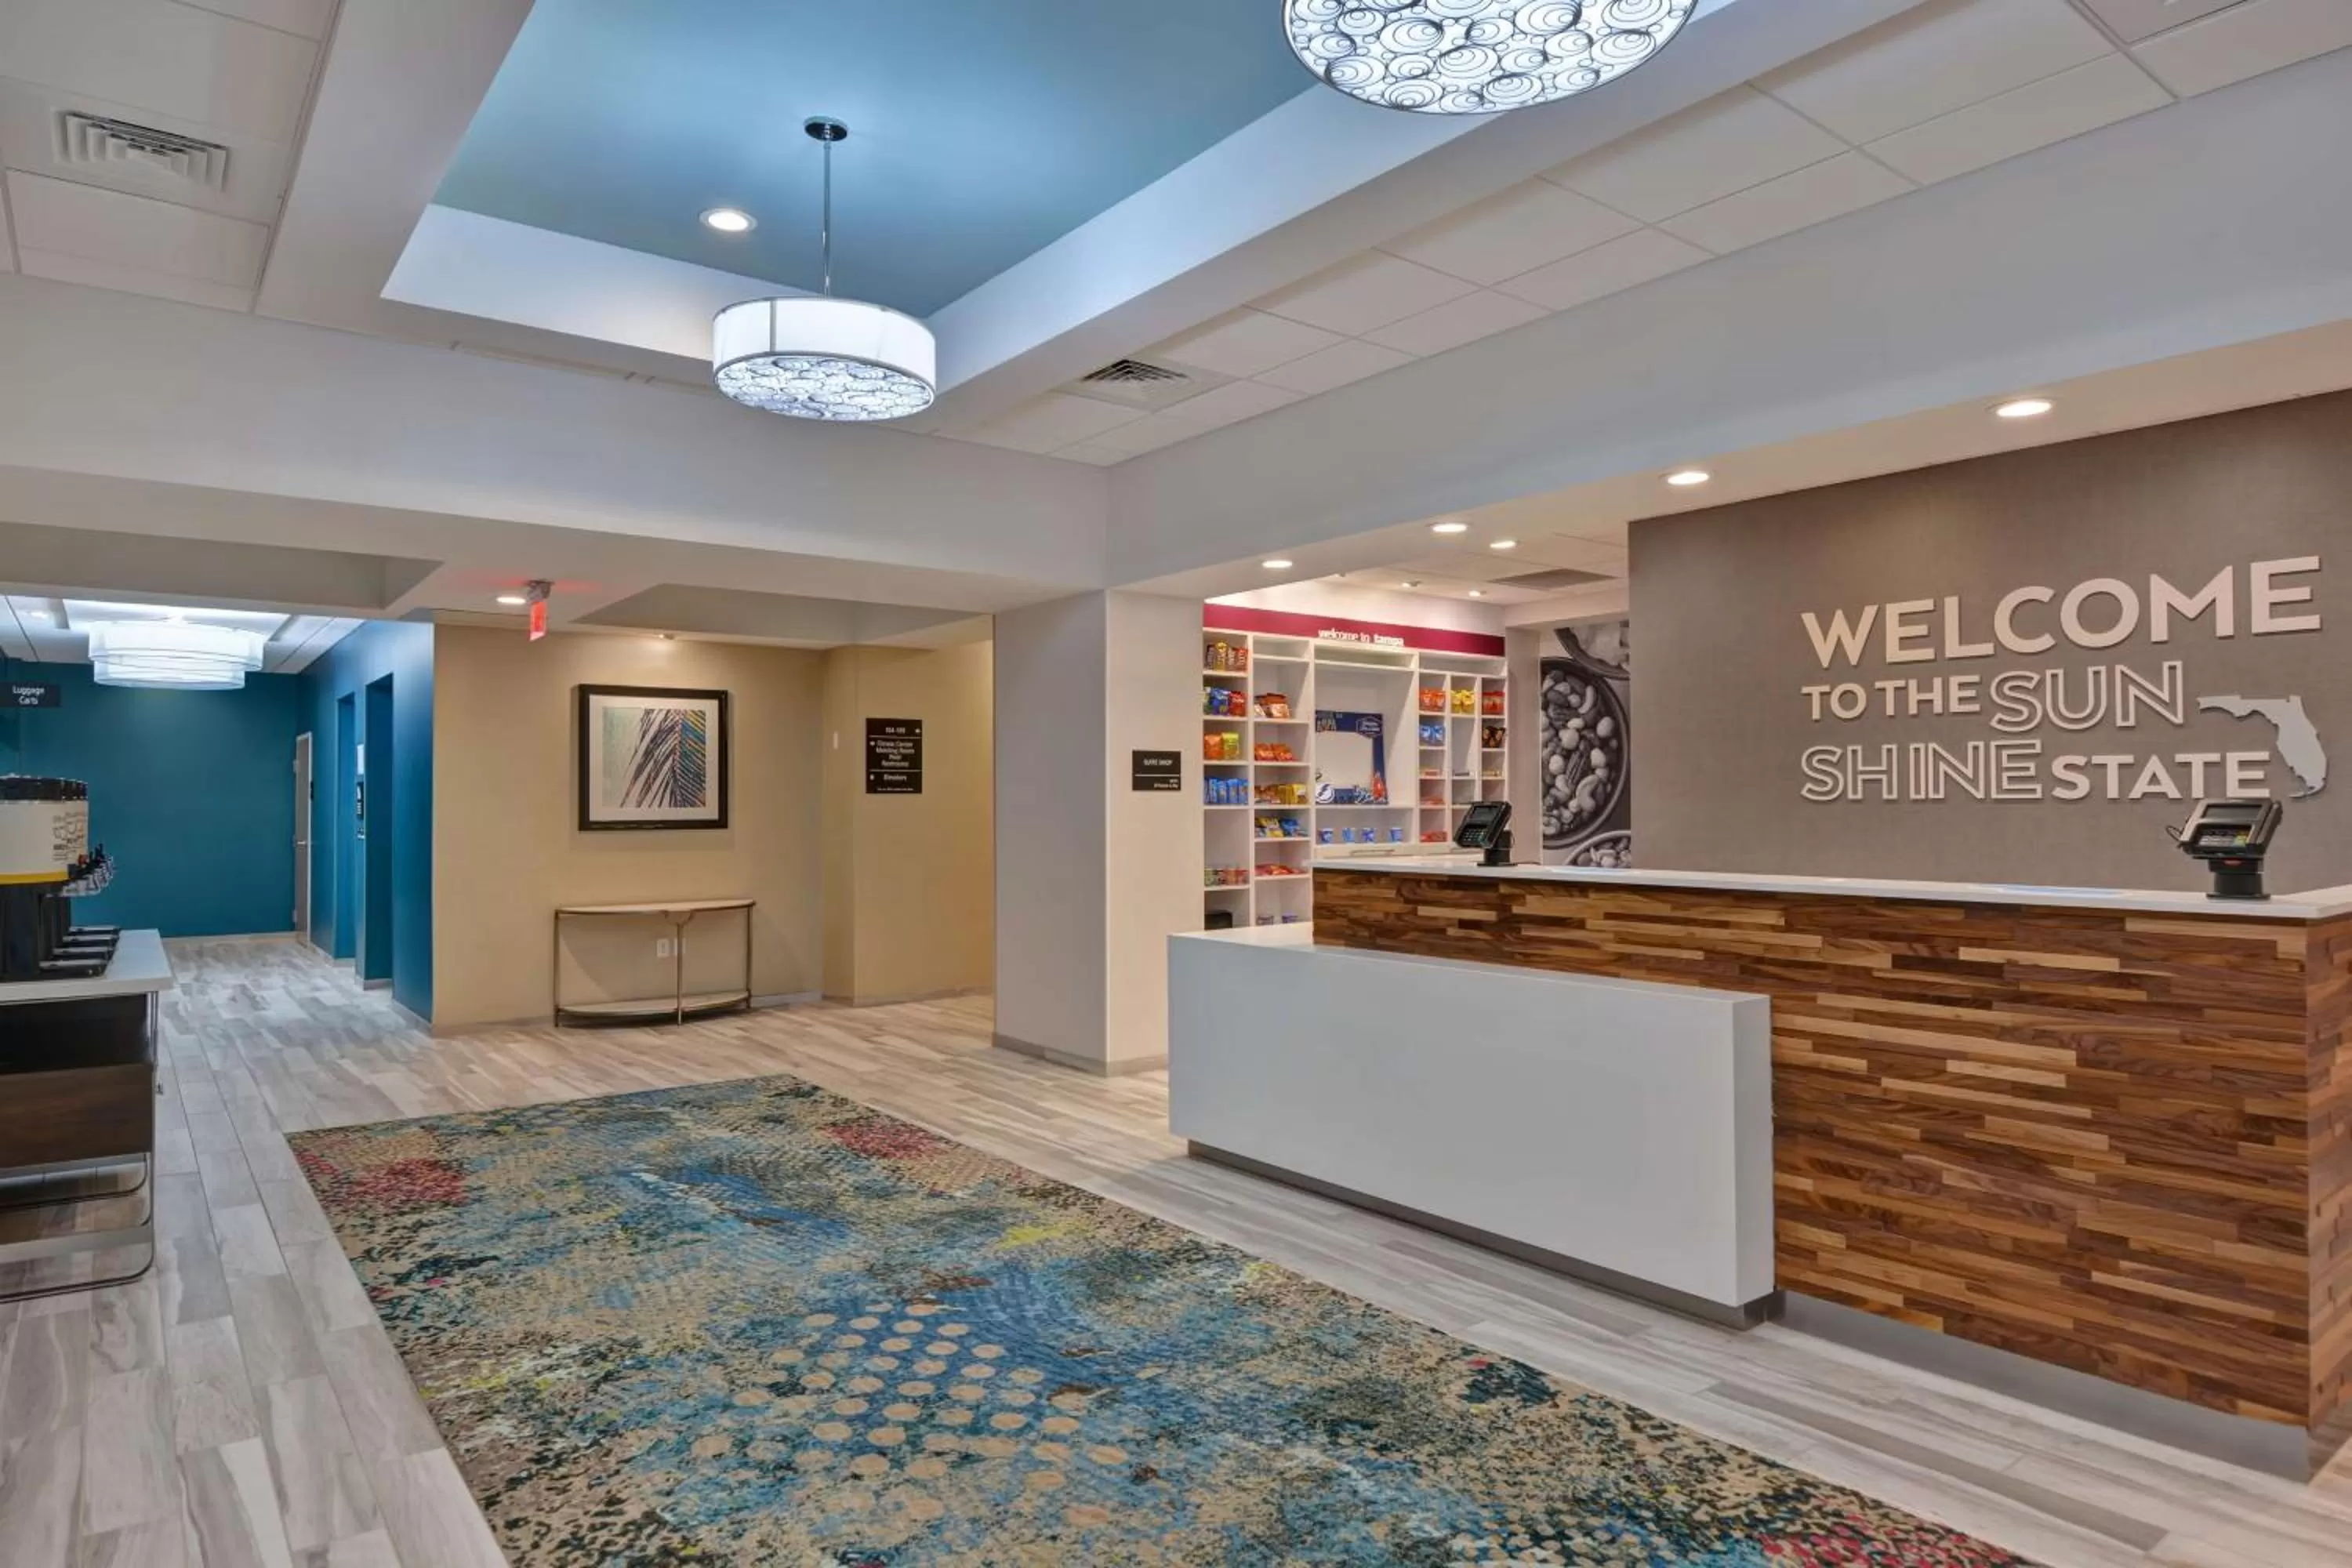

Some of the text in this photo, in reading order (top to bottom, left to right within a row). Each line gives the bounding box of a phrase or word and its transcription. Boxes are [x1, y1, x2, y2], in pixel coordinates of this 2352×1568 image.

[1318, 627, 1359, 641] welcome
[1360, 632, 1370, 644] to
[1801, 555, 2321, 669] WELCOME
[12, 684, 45, 696] Luggage
[1801, 660, 2184, 732] TO THE SUN
[1801, 739, 2271, 800] SHINE STATE
